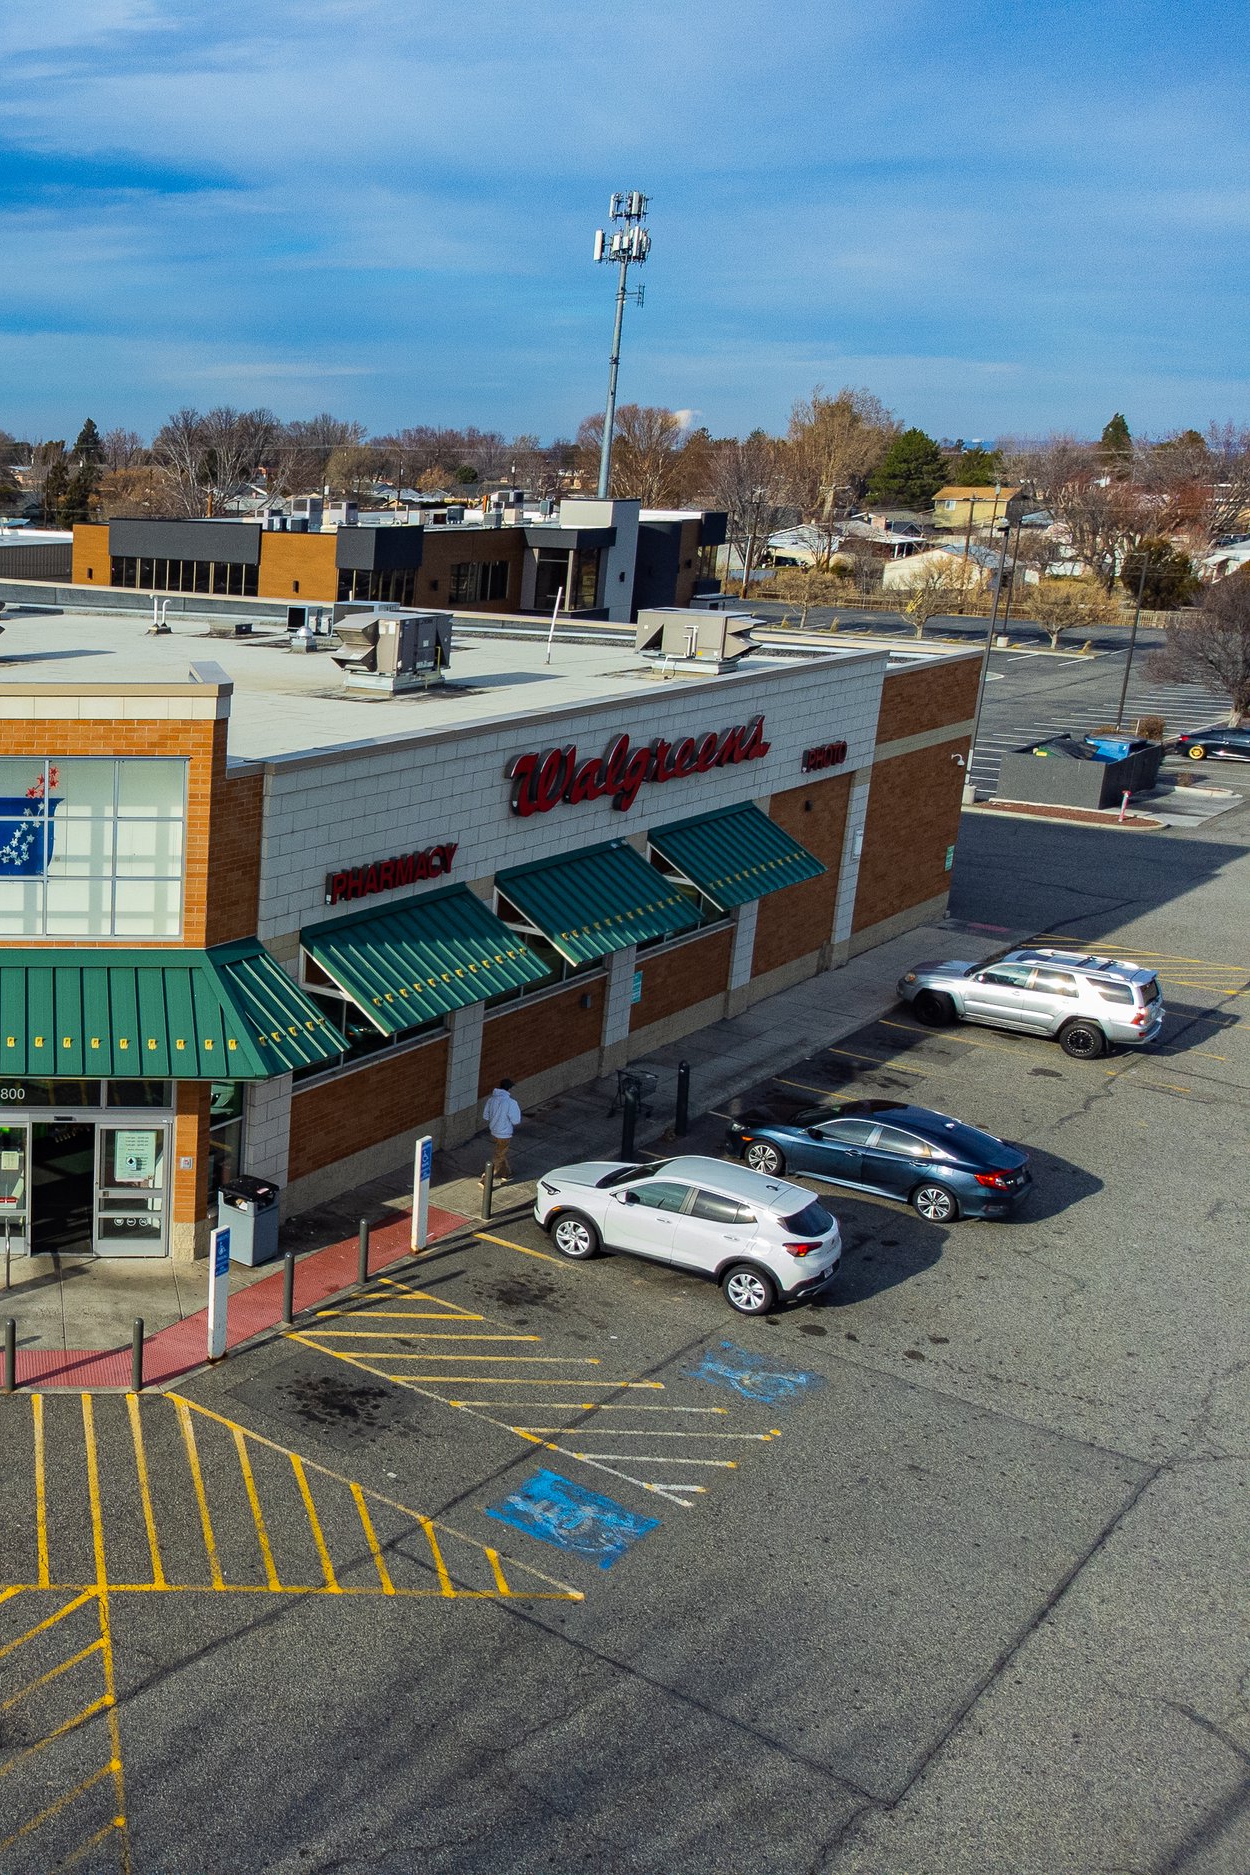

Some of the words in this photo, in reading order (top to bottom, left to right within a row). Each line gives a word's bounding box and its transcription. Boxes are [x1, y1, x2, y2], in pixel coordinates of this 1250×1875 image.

[506, 714, 771, 817] Walgreens
[803, 740, 848, 773] PHOTO
[327, 842, 459, 906] PHARMACY
